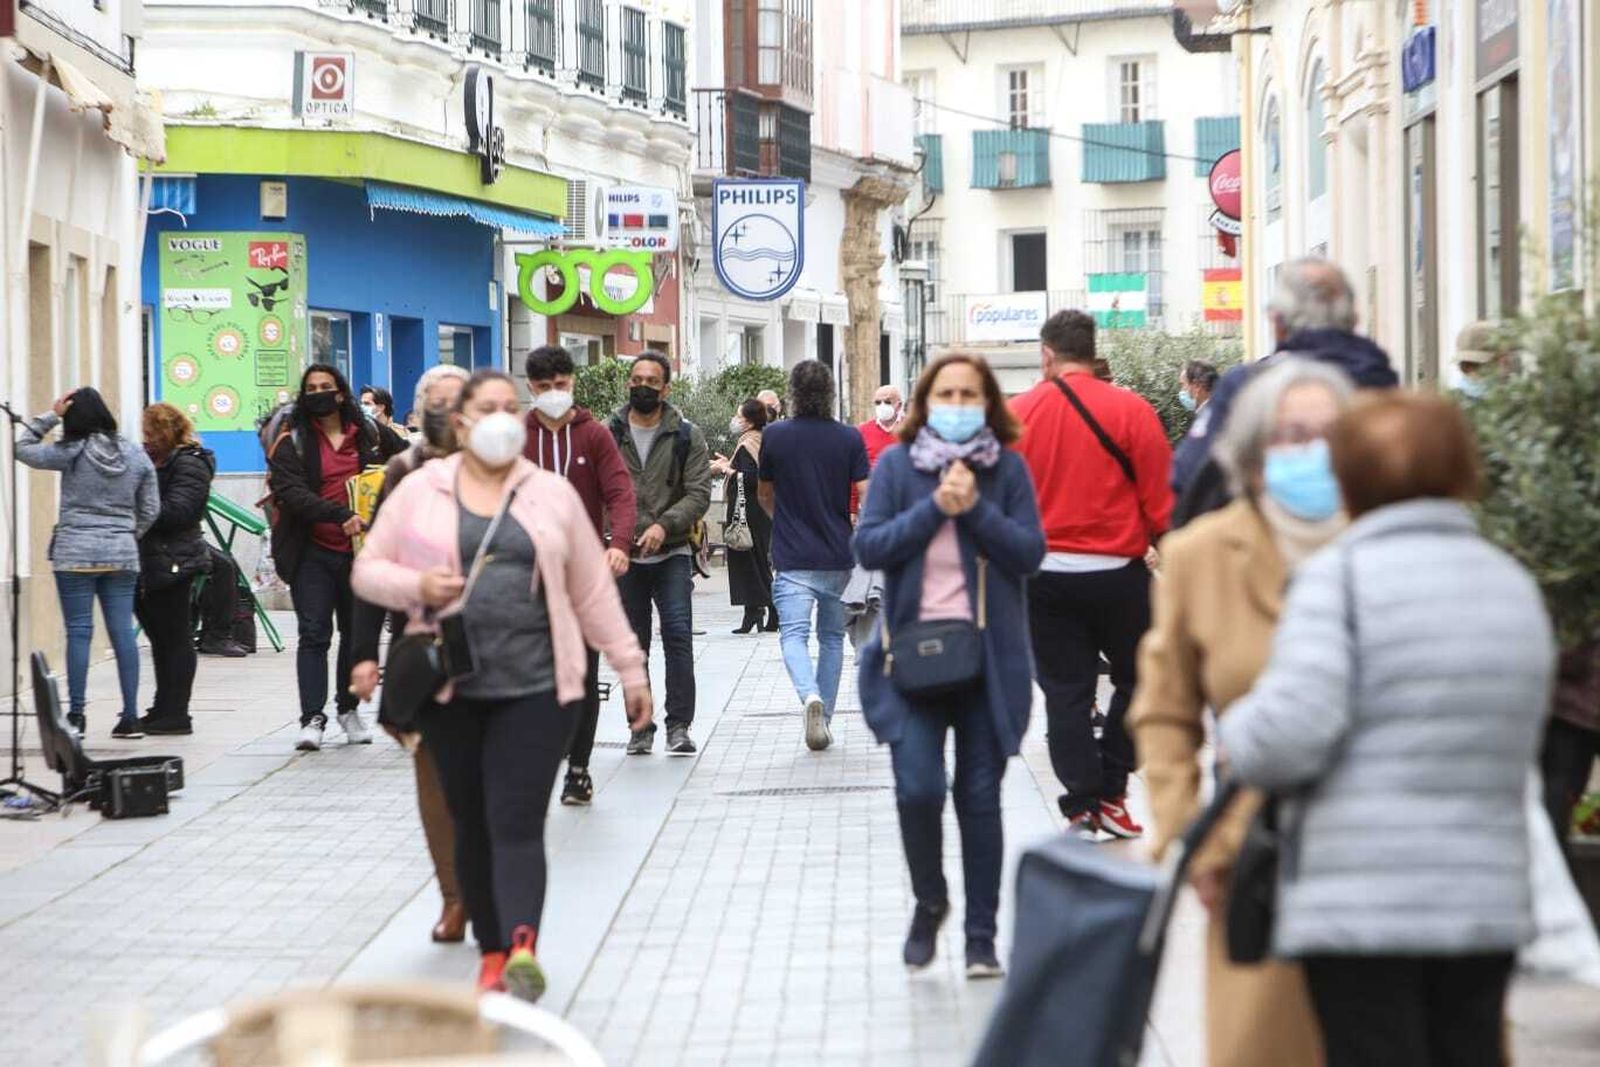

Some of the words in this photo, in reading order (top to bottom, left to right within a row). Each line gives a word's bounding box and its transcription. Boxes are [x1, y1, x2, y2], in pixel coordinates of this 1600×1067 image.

[607, 193, 640, 203] HILIPS
[719, 188, 797, 205] PHILIPS
[170, 239, 222, 251] VOGUE
[624, 236, 667, 248] OLOR
[975, 305, 1040, 326] populares
